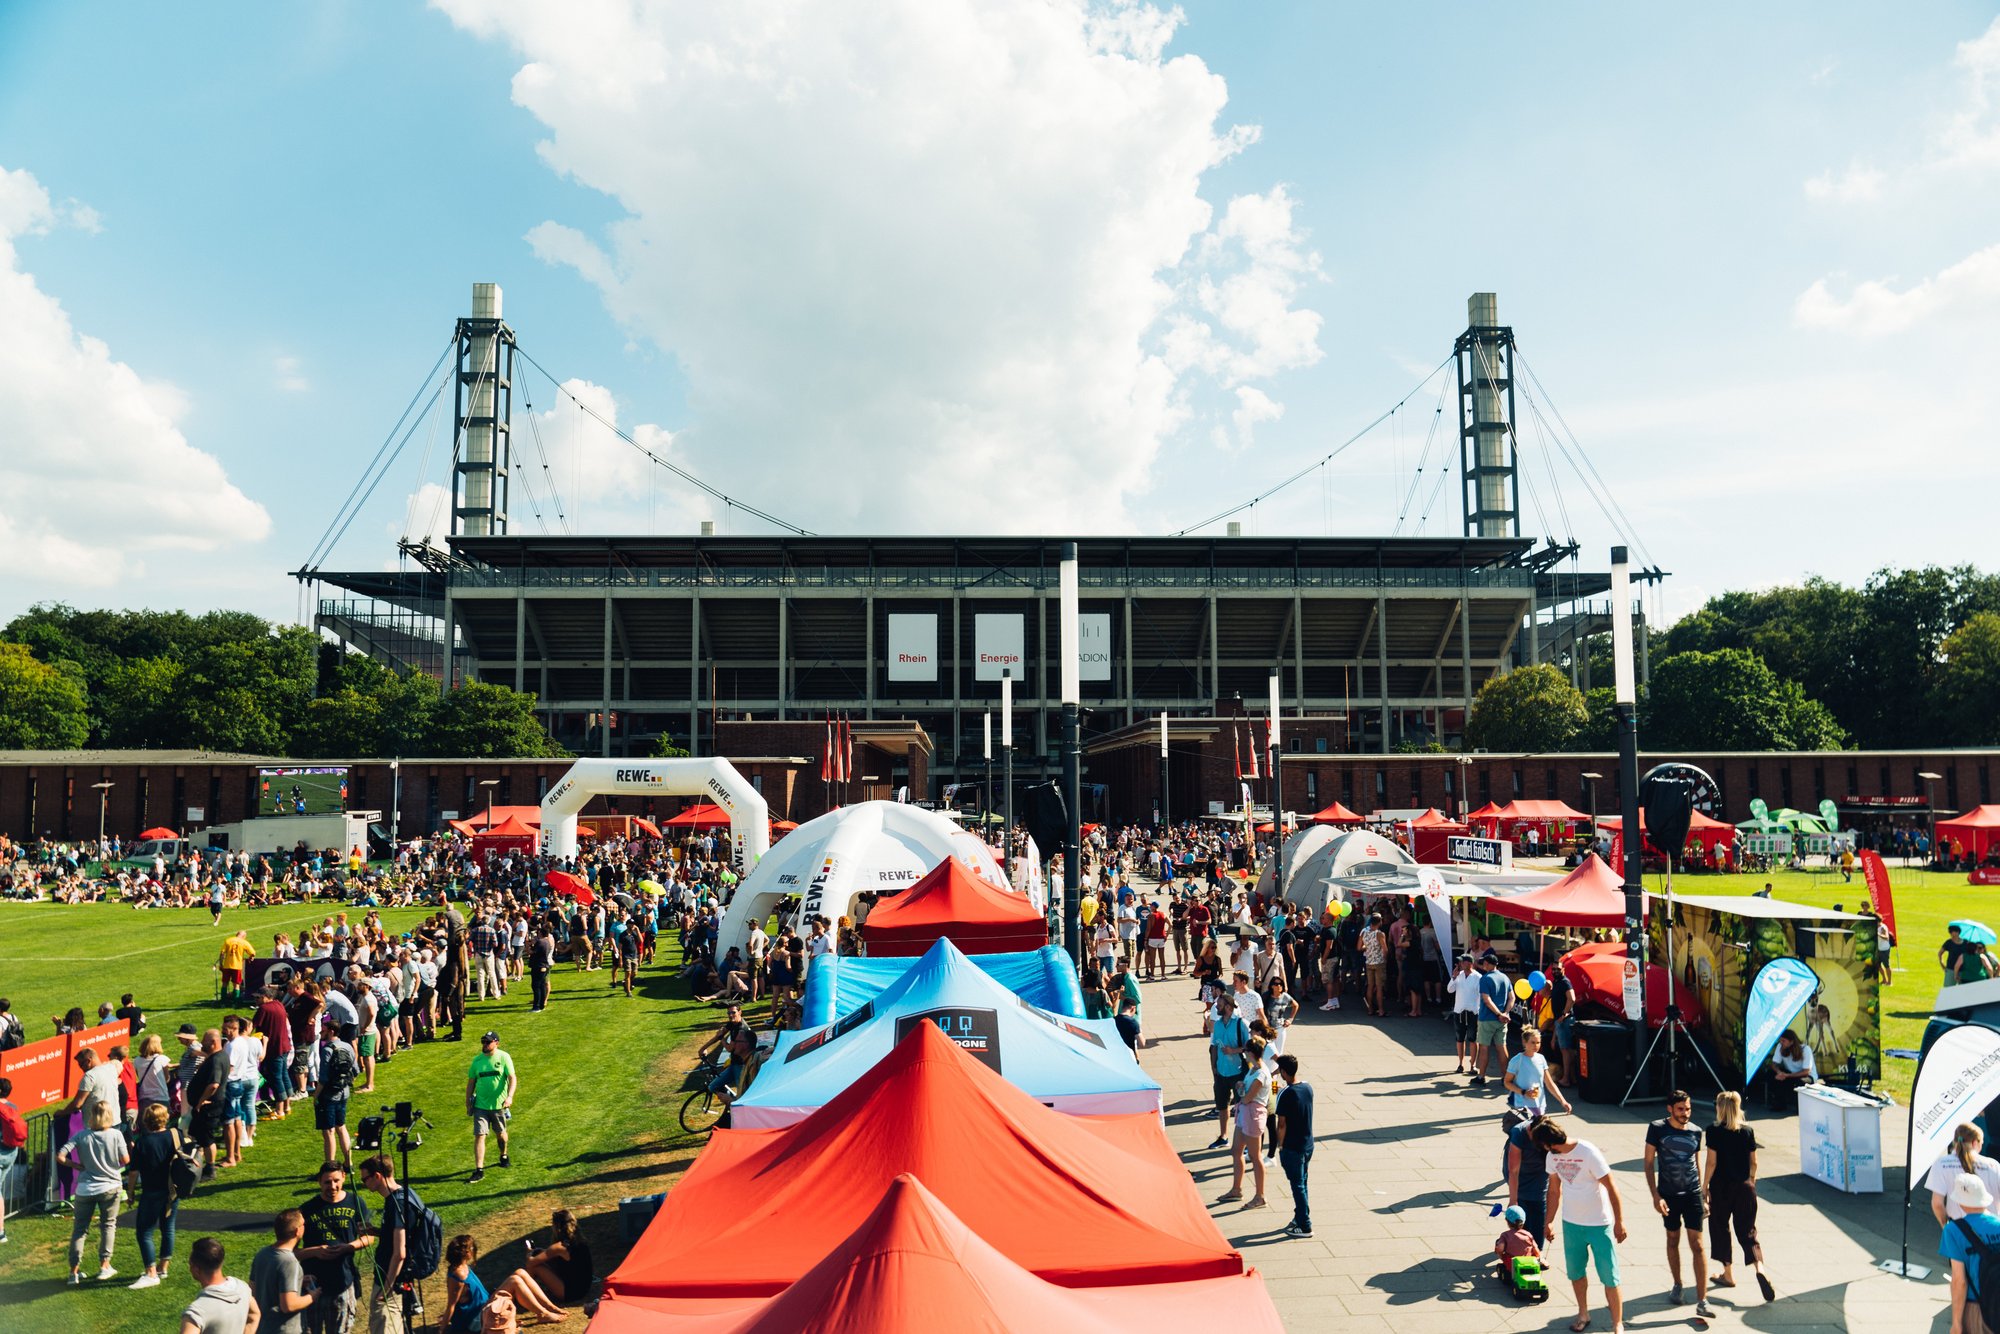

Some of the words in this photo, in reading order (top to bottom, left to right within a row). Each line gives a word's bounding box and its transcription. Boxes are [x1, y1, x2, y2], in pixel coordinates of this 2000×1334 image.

[899, 654, 927, 663] Rhein
[980, 654, 1019, 664] Energie
[616, 769, 650, 782] REWE
[548, 783, 569, 805] REWE
[708, 778, 729, 802] REWE
[1455, 839, 1473, 859] Gaffel
[1473, 841, 1495, 863] Kölsch
[778, 874, 797, 884] REWE
[879, 870, 914, 881] REWE
[803, 873, 828, 926] REWE
[6, 1063, 15, 1072] Die
[14, 1060, 25, 1070] rote
[1915, 1102, 1946, 1134] Kölner
[311, 1207, 356, 1222] HLLISTER
